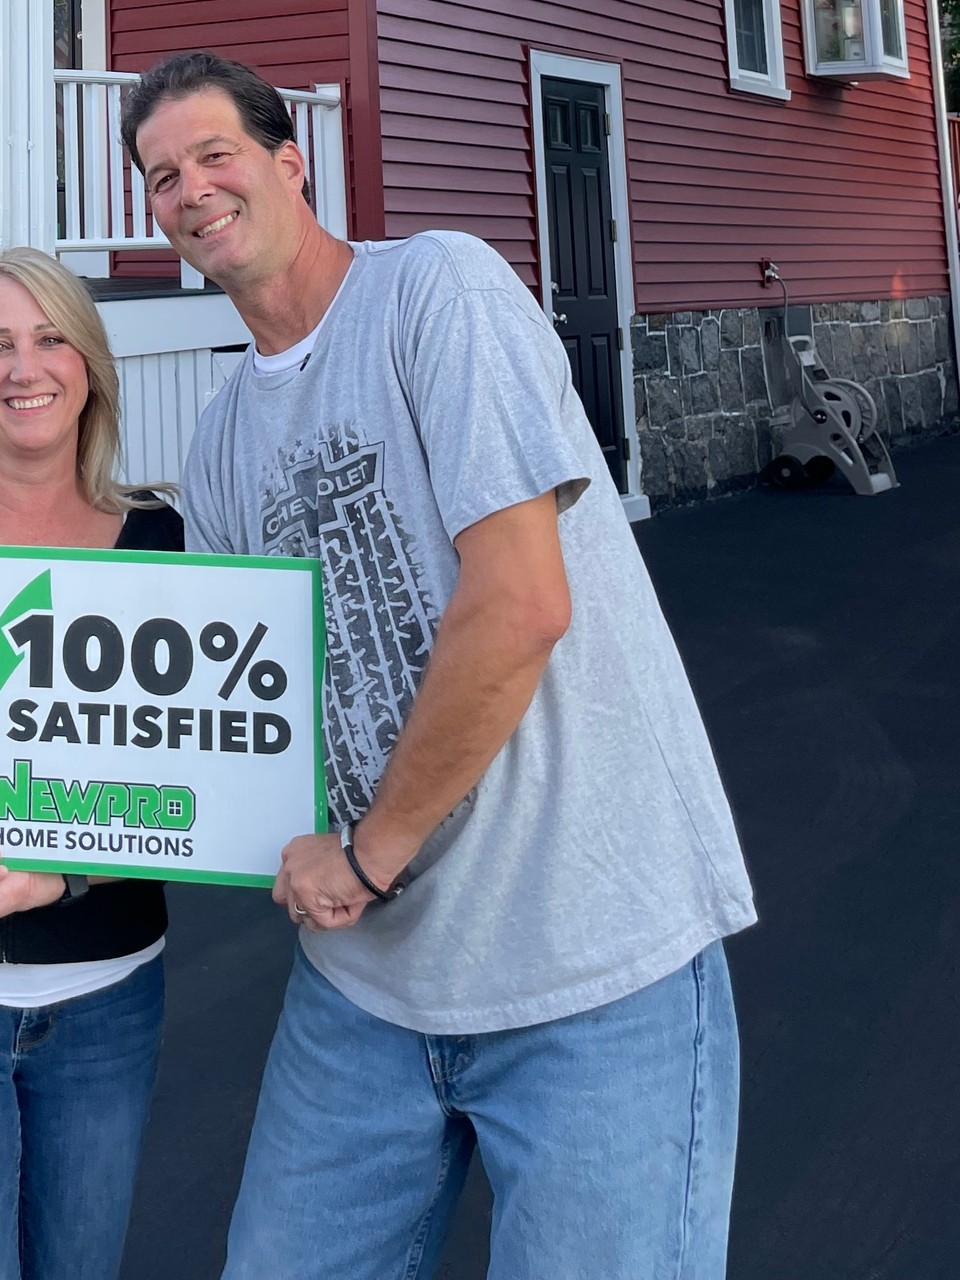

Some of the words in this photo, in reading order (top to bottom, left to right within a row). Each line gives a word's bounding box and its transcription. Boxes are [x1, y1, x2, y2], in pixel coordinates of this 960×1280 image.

[266, 461, 368, 535] CHEVOLET
[8, 614, 288, 701] 100%
[6, 698, 292, 755] SATISFIED
[64, 829, 194, 858] SOLUTIONS
